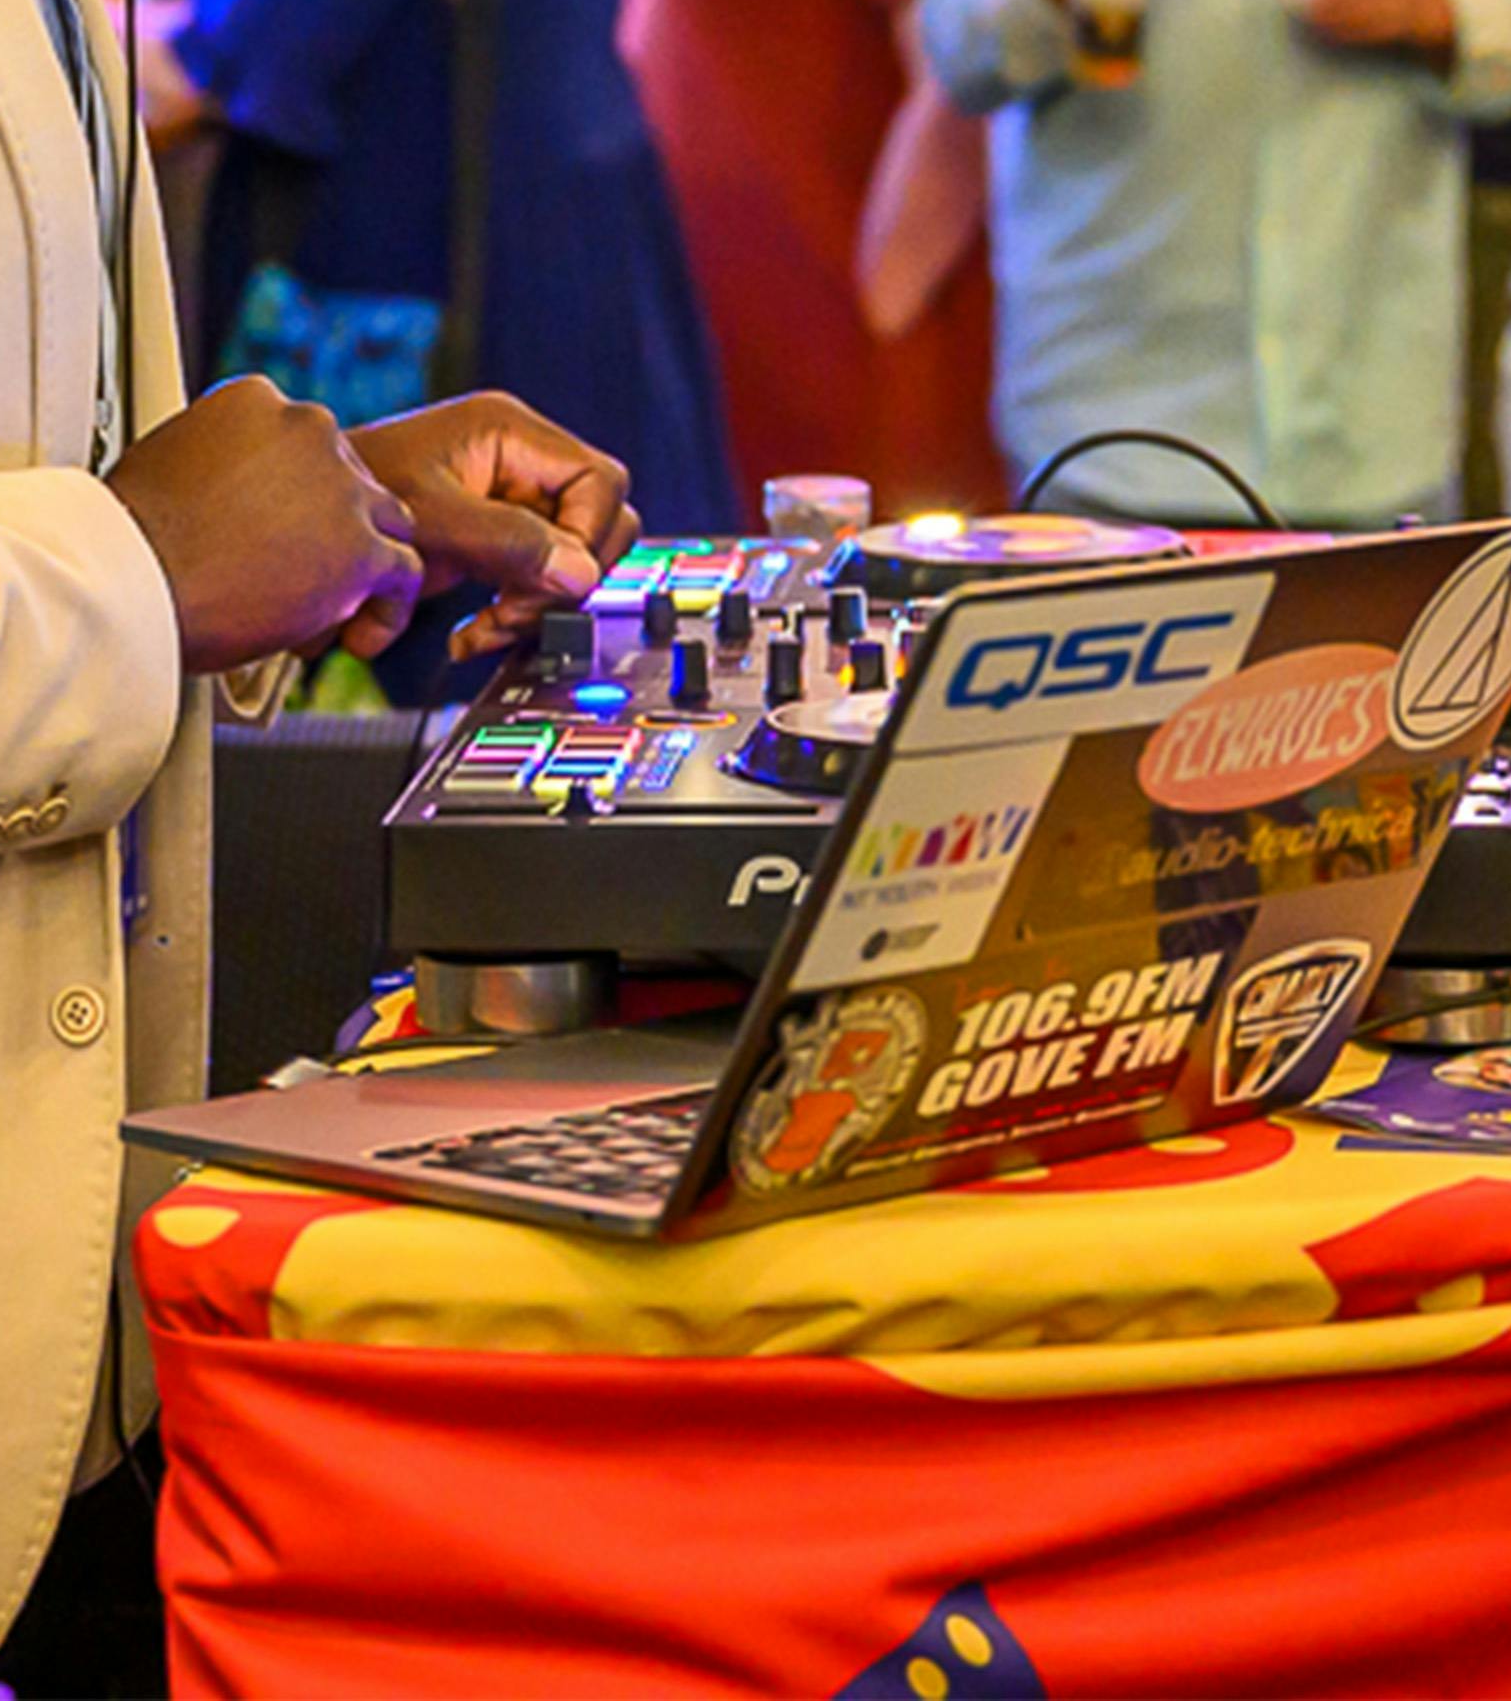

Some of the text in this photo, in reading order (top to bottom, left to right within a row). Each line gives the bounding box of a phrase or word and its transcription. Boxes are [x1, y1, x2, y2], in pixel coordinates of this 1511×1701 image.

[945, 613, 1235, 710] QSC
[954, 951, 1223, 1056] 106.9FM
[916, 1033, 1094, 1117] GOVE
[1093, 1012, 1196, 1078] FM
